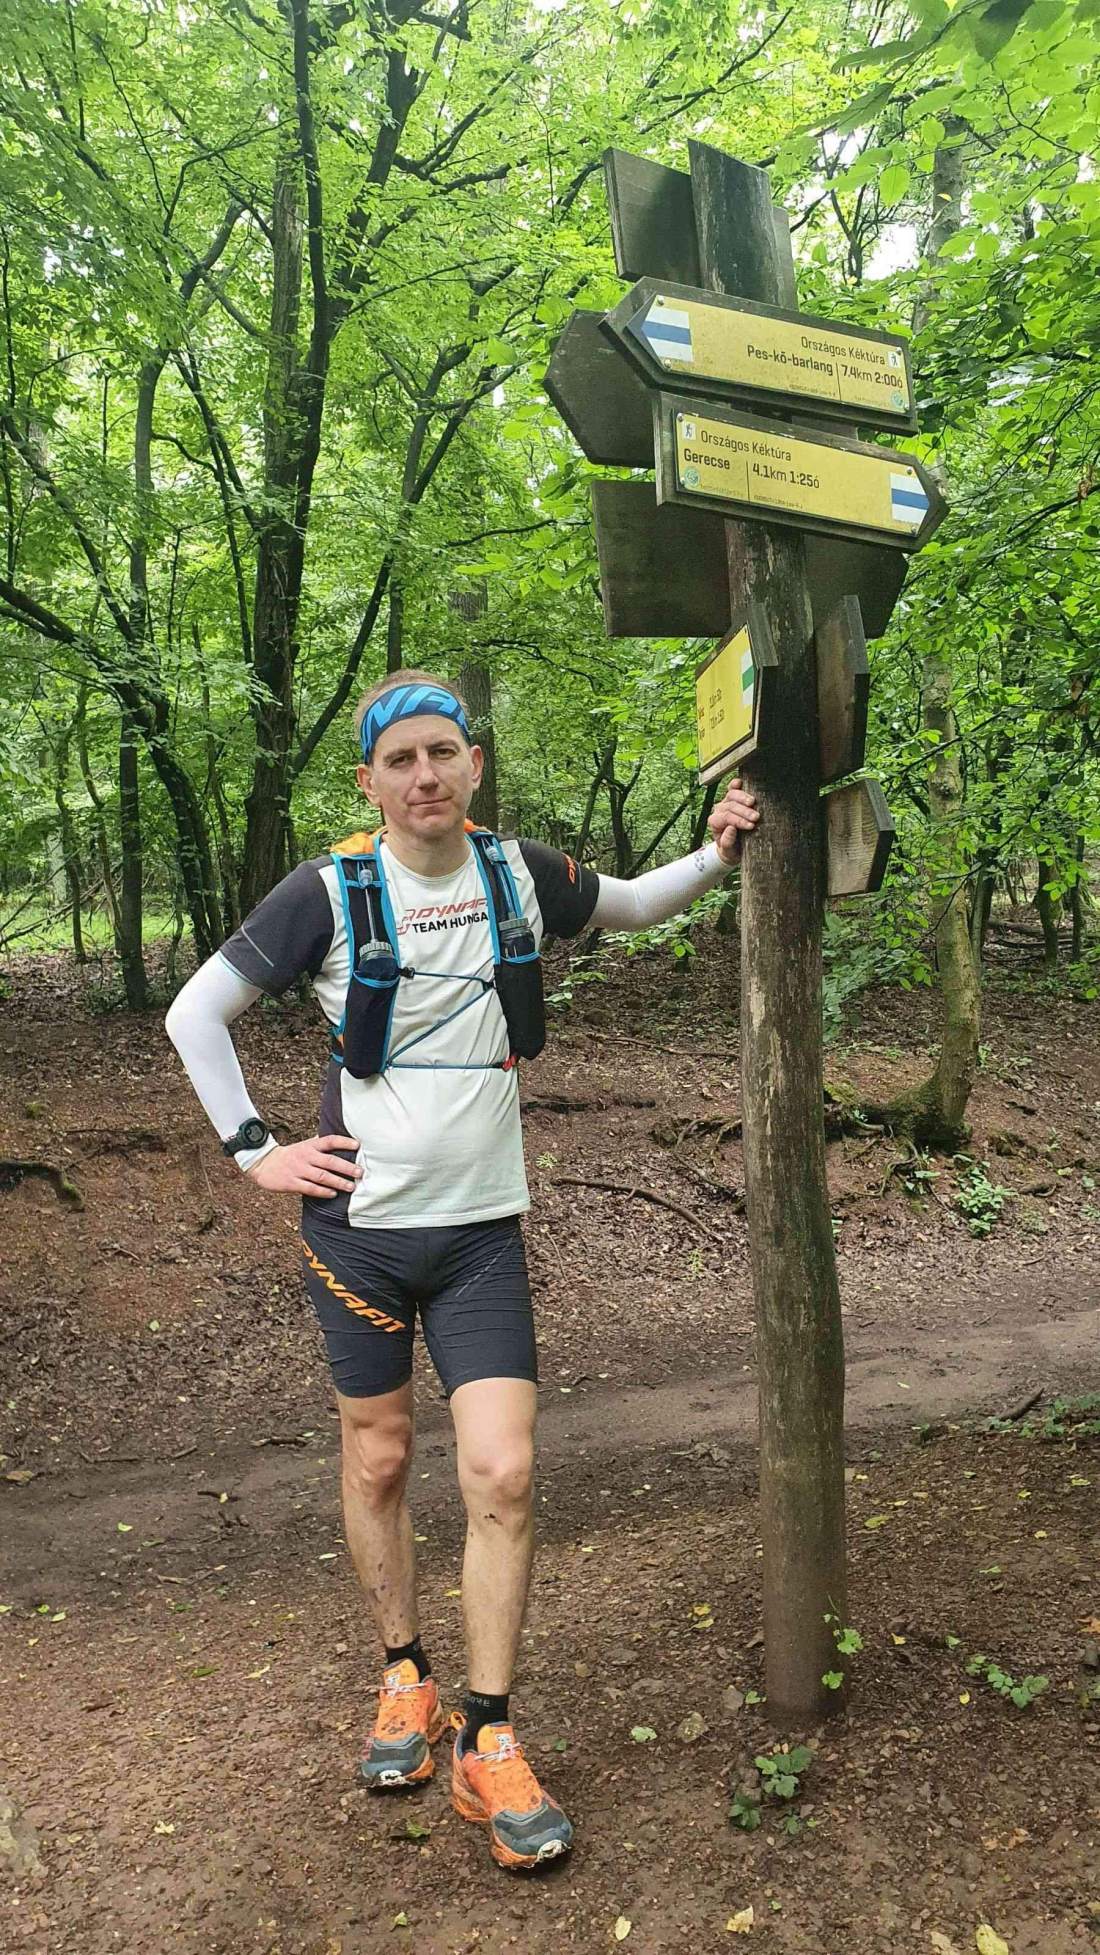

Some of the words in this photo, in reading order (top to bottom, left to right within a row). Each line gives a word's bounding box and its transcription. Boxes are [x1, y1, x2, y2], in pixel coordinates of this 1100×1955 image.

[747, 344, 834, 377] Pes-kő-barlang
[841, 364, 873, 382] 7.4km
[801, 336, 847, 357] Országos
[848, 346, 886, 365] Kéktúra
[701, 430, 750, 453] Országos
[752, 441, 792, 461] Kéktúra
[684, 448, 731, 470] Gerecse
[752, 463, 787, 482] 4.1km
[789, 471, 820, 489] 1:25ó
[412, 919, 448, 933] TEAM
[449, 911, 489, 929] HUNGA
[416, 897, 488, 919] DYNAF
